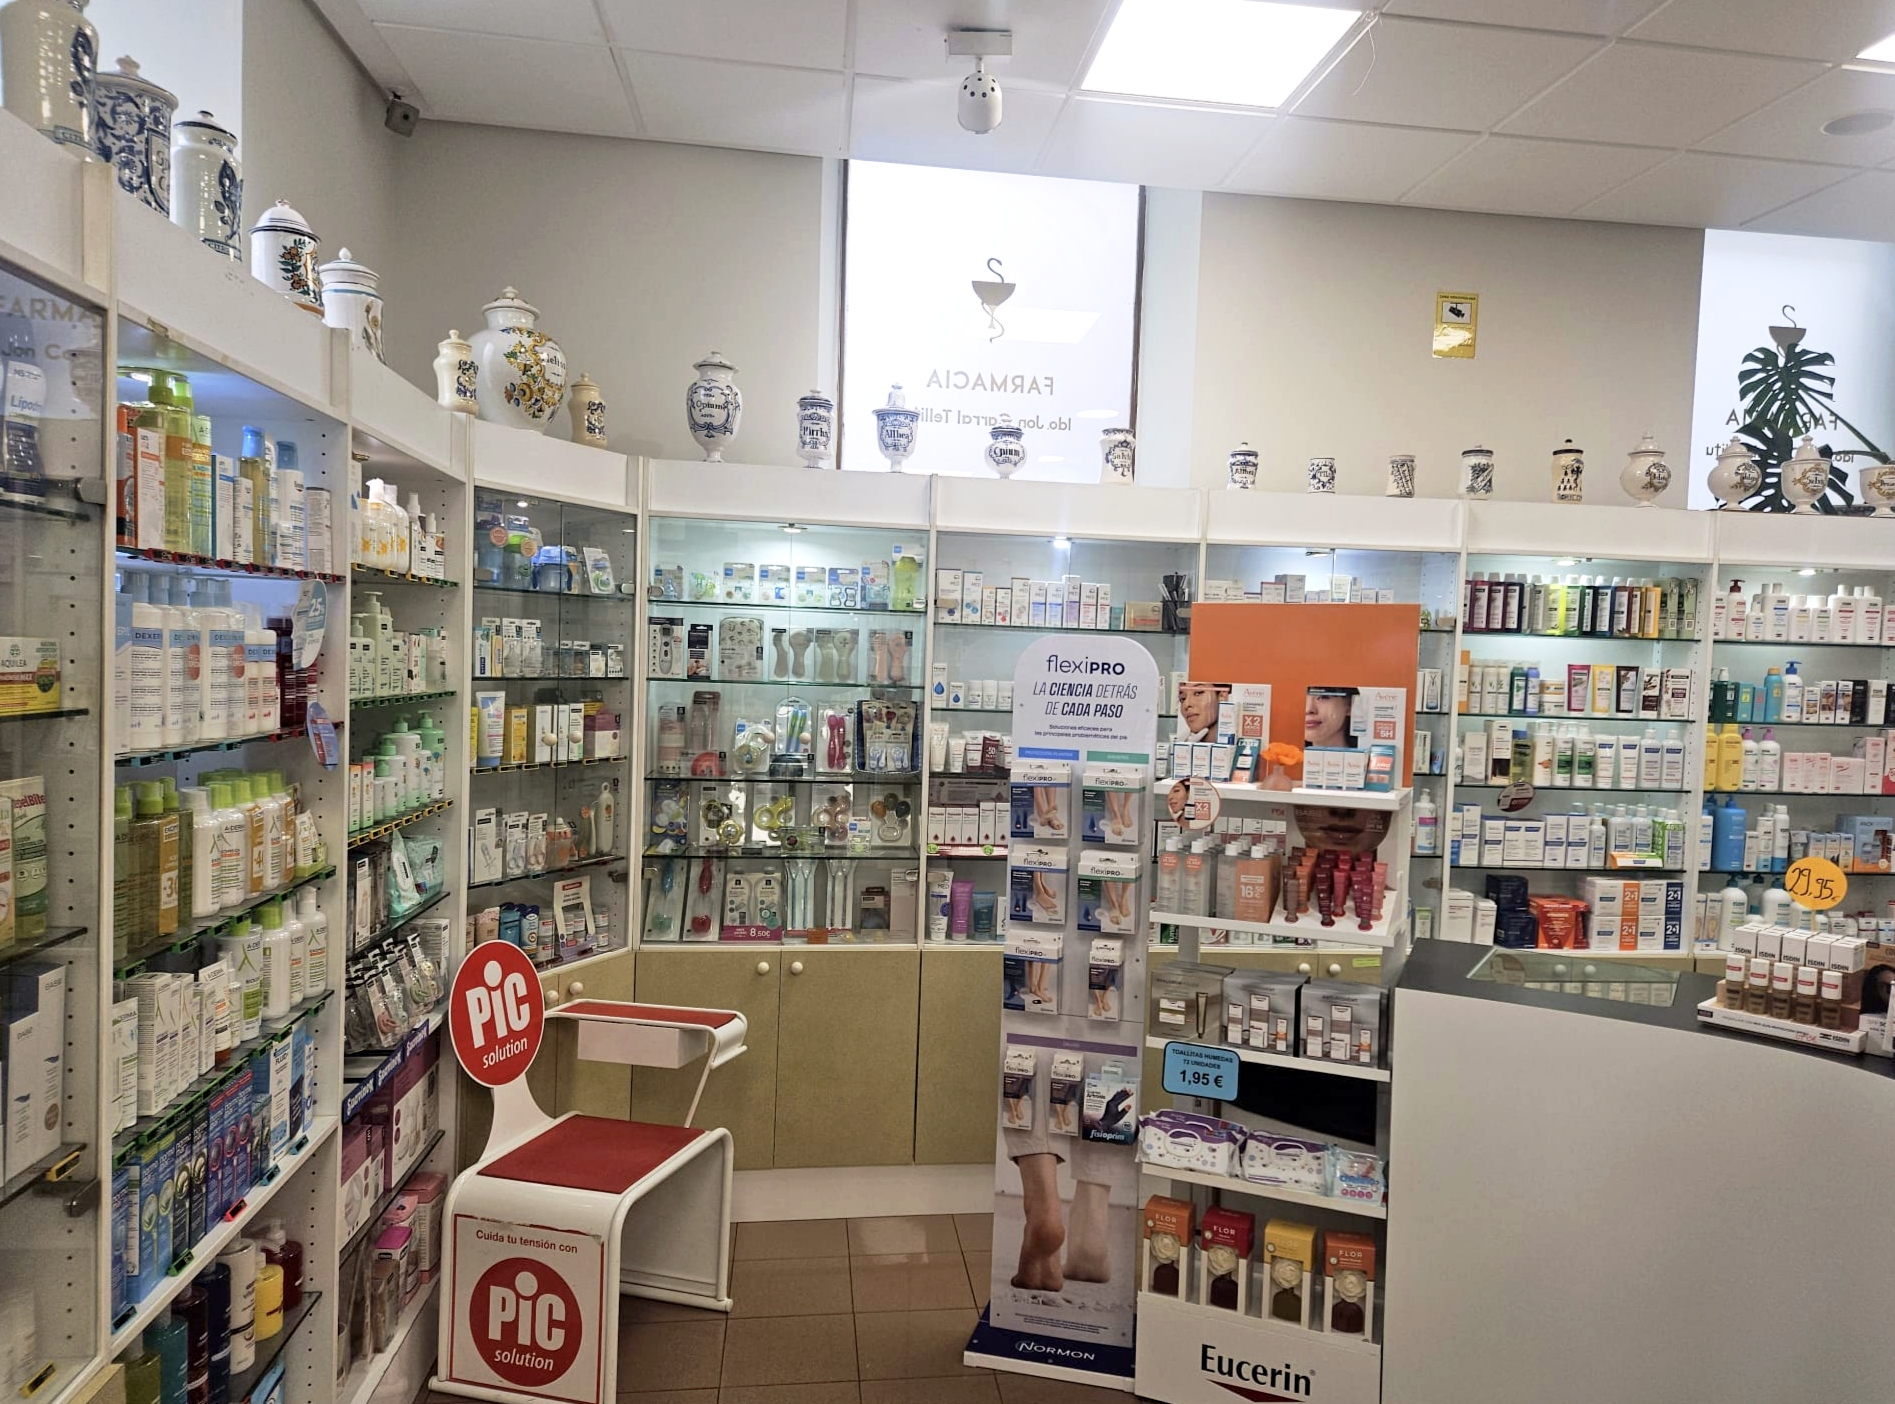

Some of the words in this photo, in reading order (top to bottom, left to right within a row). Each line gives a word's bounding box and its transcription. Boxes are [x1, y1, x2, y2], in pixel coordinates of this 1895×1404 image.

[695, 399, 725, 411] Opium
[1046, 654, 1125, 676] flexiPRO
[1033, 681, 1046, 696] LA
[1049, 682, 1093, 698] CIENCIA
[1095, 683, 1138, 700] DETRÁS
[1045, 702, 1059, 715] DE
[1061, 702, 1090, 717] CADA
[1094, 704, 1123, 718] PASO
[1735, 947, 1752, 955] ISDIN
[1759, 951, 1776, 959] ISDIN
[1783, 955, 1801, 963] ISDIN
[1807, 959, 1825, 968] ISDIN
[1831, 963, 1849, 972] ISDIN
[465, 960, 530, 1049] PiC
[482, 1036, 528, 1069] solution
[1172, 1049, 1203, 1058] TOALLITAS
[1204, 1054, 1233, 1063] HUMEDAS
[1180, 1070, 1210, 1086] 1,95
[1214, 1075, 1223, 1088] €
[1090, 1129, 1125, 1141] fisioprim
[1156, 1214, 1177, 1223] FLOR
[1214, 1226, 1235, 1235] FLOR
[476, 1229, 504, 1243] Cuida
[507, 1234, 517, 1244] tu
[519, 1237, 556, 1251] tensión
[559, 1243, 578, 1254] con
[488, 1271, 566, 1351] PiC
[1019, 1342, 1095, 1360] NORMON
[494, 1348, 554, 1371] solution
[1200, 1343, 1312, 1397] Eucerin
